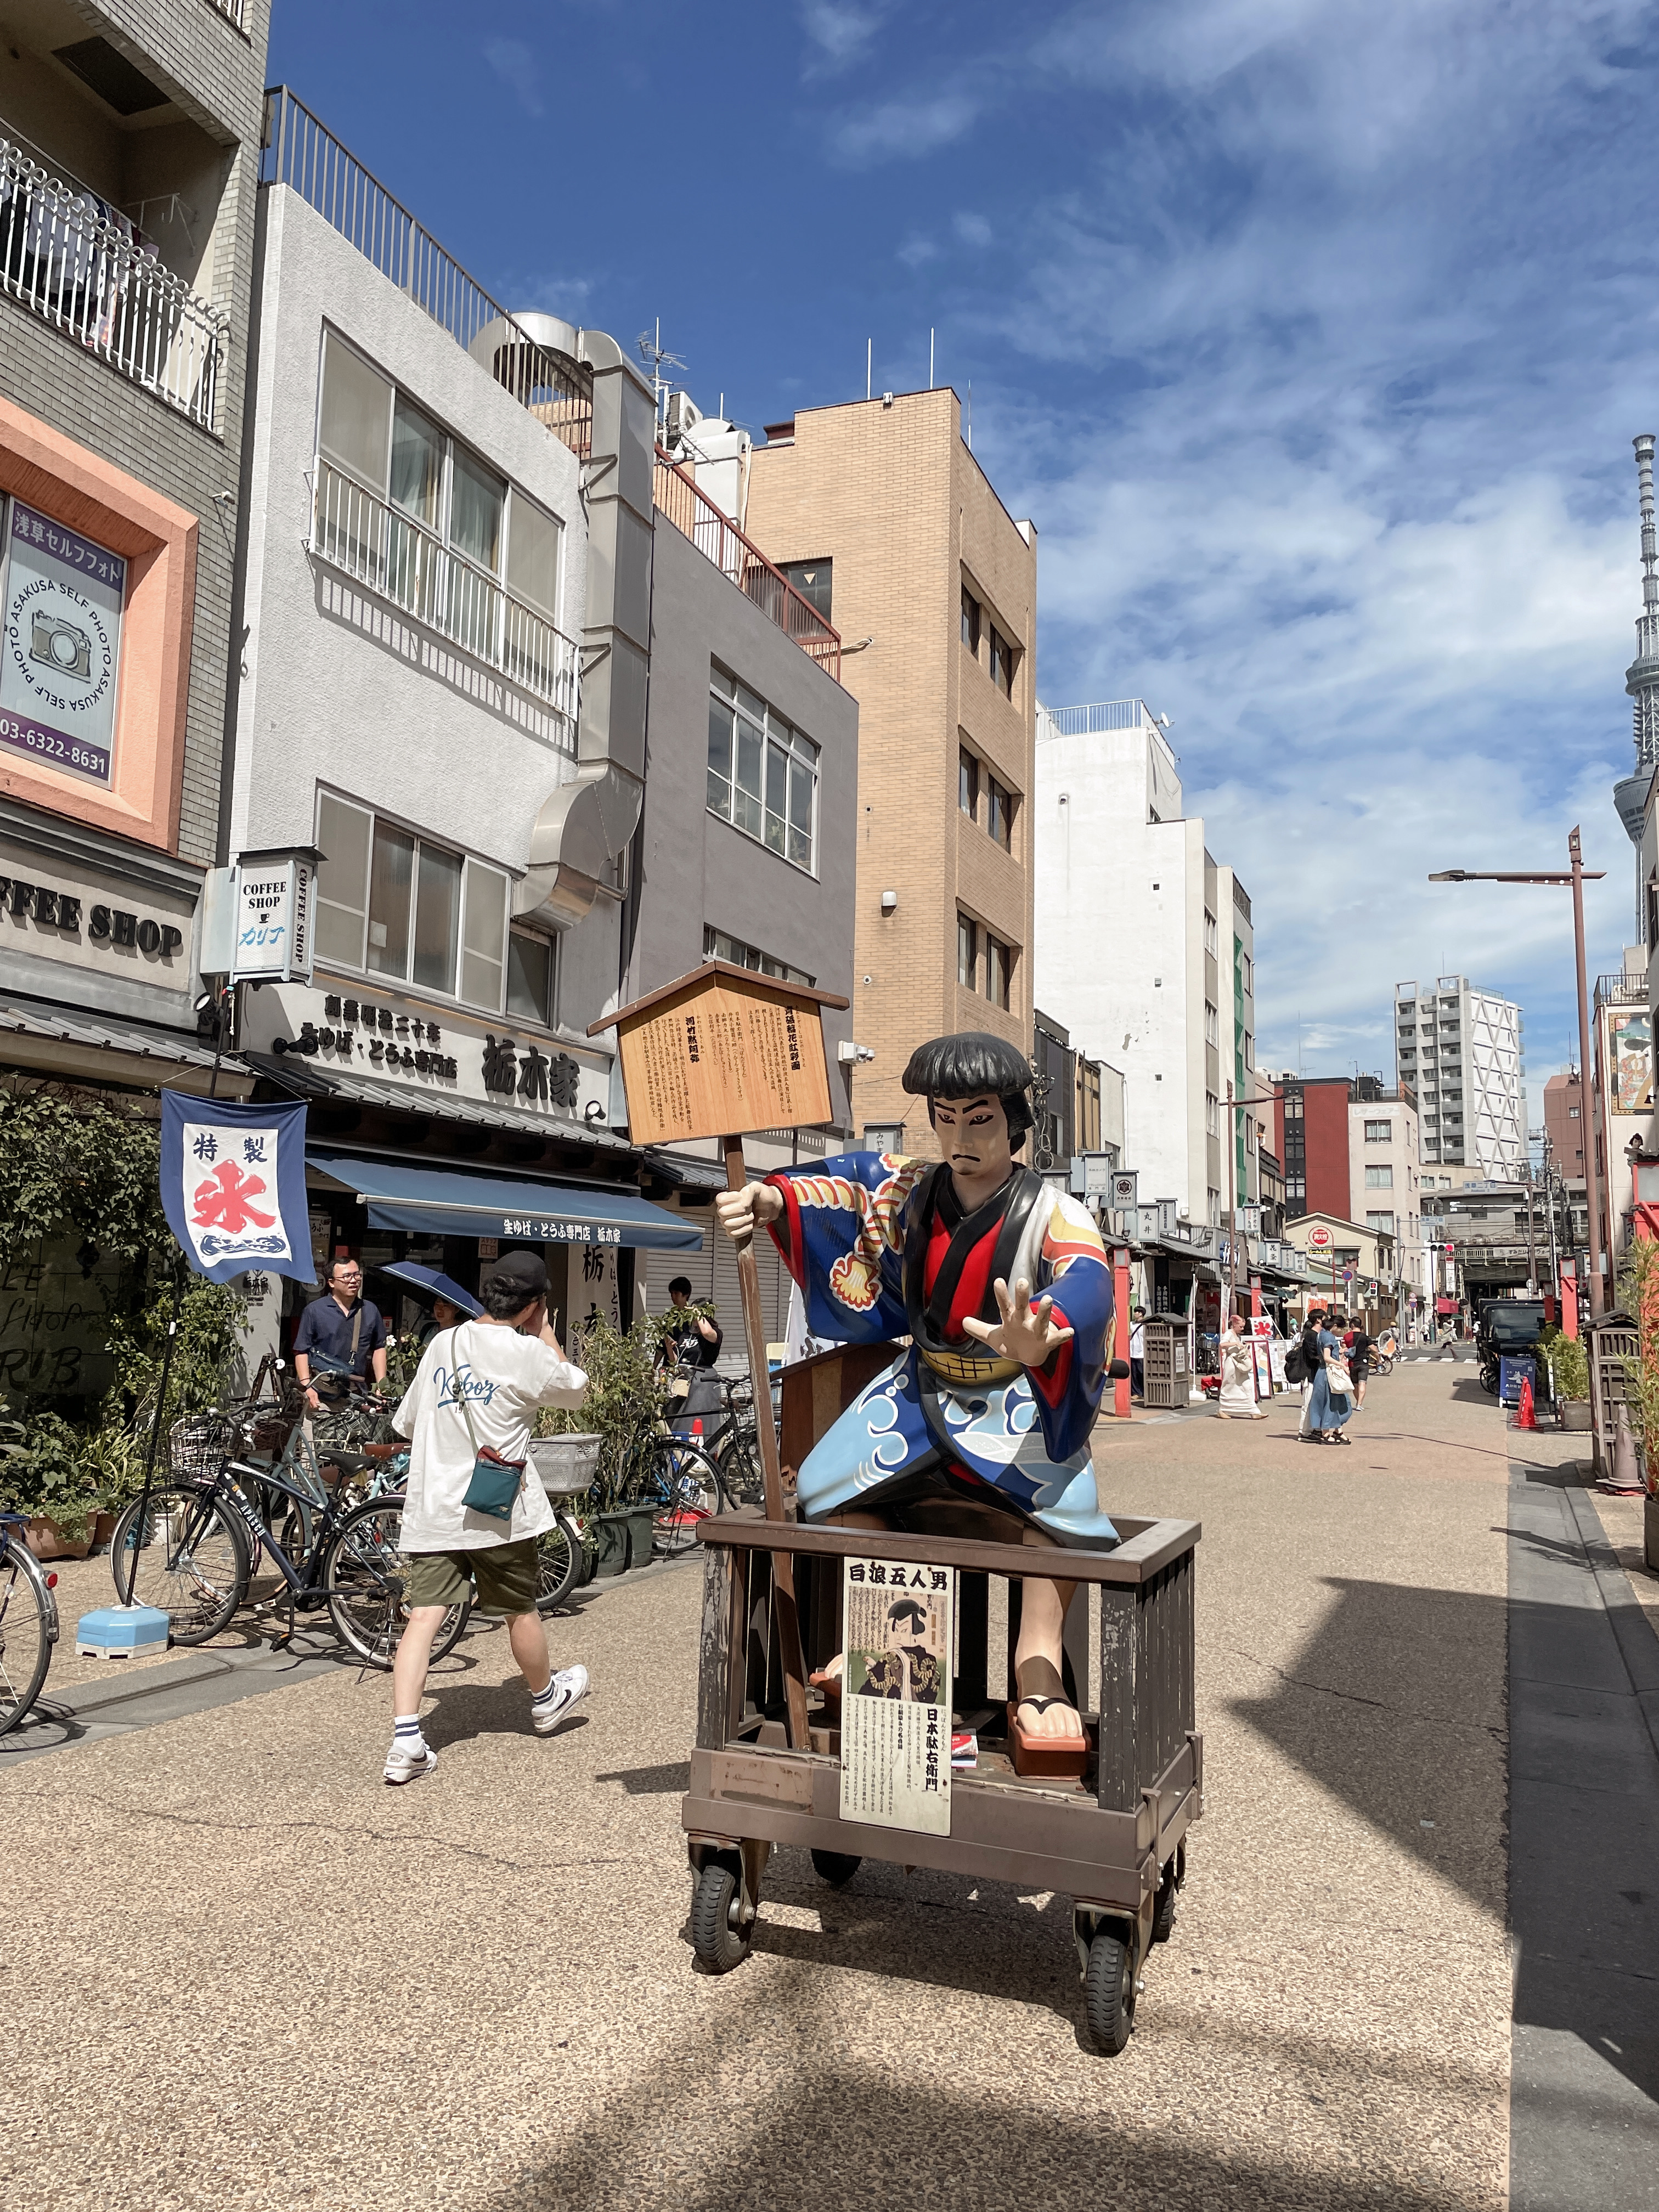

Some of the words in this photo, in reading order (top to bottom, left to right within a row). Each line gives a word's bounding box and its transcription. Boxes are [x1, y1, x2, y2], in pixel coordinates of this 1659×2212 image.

[14, 511, 120, 583] 浅草セルフフォト
[12, 579, 56, 624] ASAKUSA
[59, 583, 89, 610] SELF
[89, 611, 112, 665] PHOTO
[0, 718, 106, 774] 03-6322-8631
[243, 881, 286, 895] COFFEE
[249, 896, 280, 909] SHOP
[297, 868, 308, 921] COFFEE
[89, 904, 183, 957] SHOP
[295, 923, 304, 963] SHOP
[481, 1034, 580, 1108] 栃木家
[190, 1159, 276, 1234] 氷
[1143, 1212, 1152, 1234] 丸井
[504, 1218, 591, 1242] 生ゆば・とうふ専門店
[597, 1226, 621, 1244] 栃木家
[850, 1562, 948, 1592] 白浪五人男
[925, 1708, 939, 1792] 日本駄右衛門
